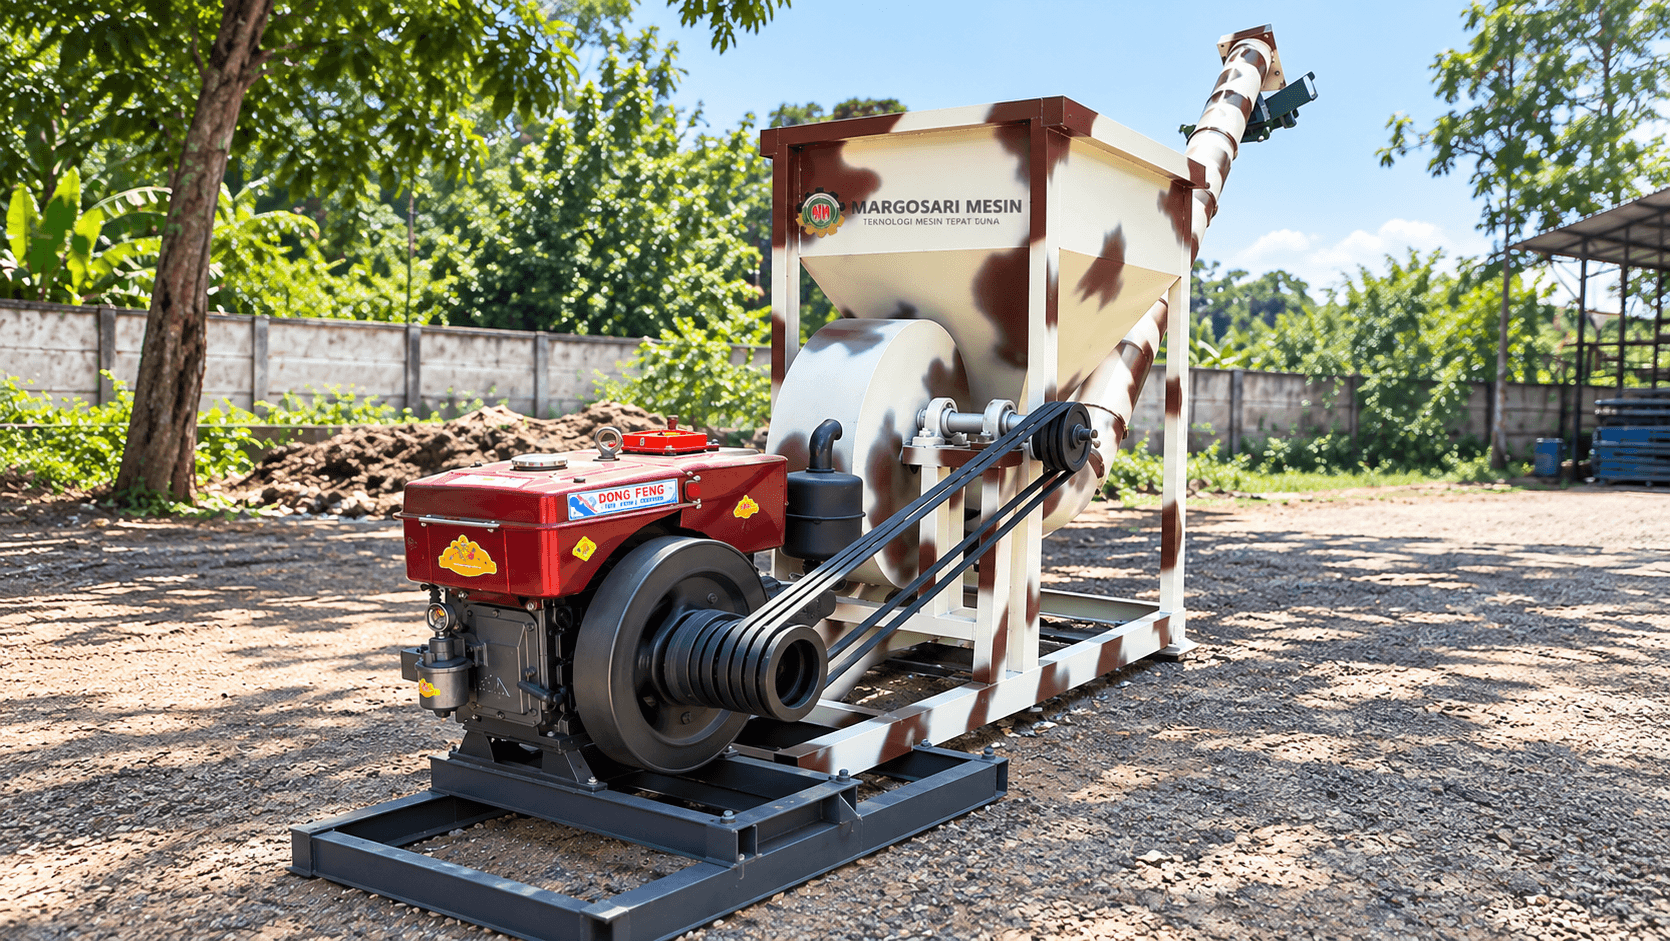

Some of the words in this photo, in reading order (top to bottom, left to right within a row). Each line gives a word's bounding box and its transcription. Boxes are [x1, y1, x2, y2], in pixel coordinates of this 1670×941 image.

[851, 199, 960, 214] MARGOSARI
[966, 199, 1022, 214] MESIN
[863, 218, 912, 226] TEKNOLOGI
[915, 217, 942, 225] MESIN
[946, 217, 972, 225] TEPAT
[598, 489, 631, 504] DONG
[635, 484, 664, 498] FENG
